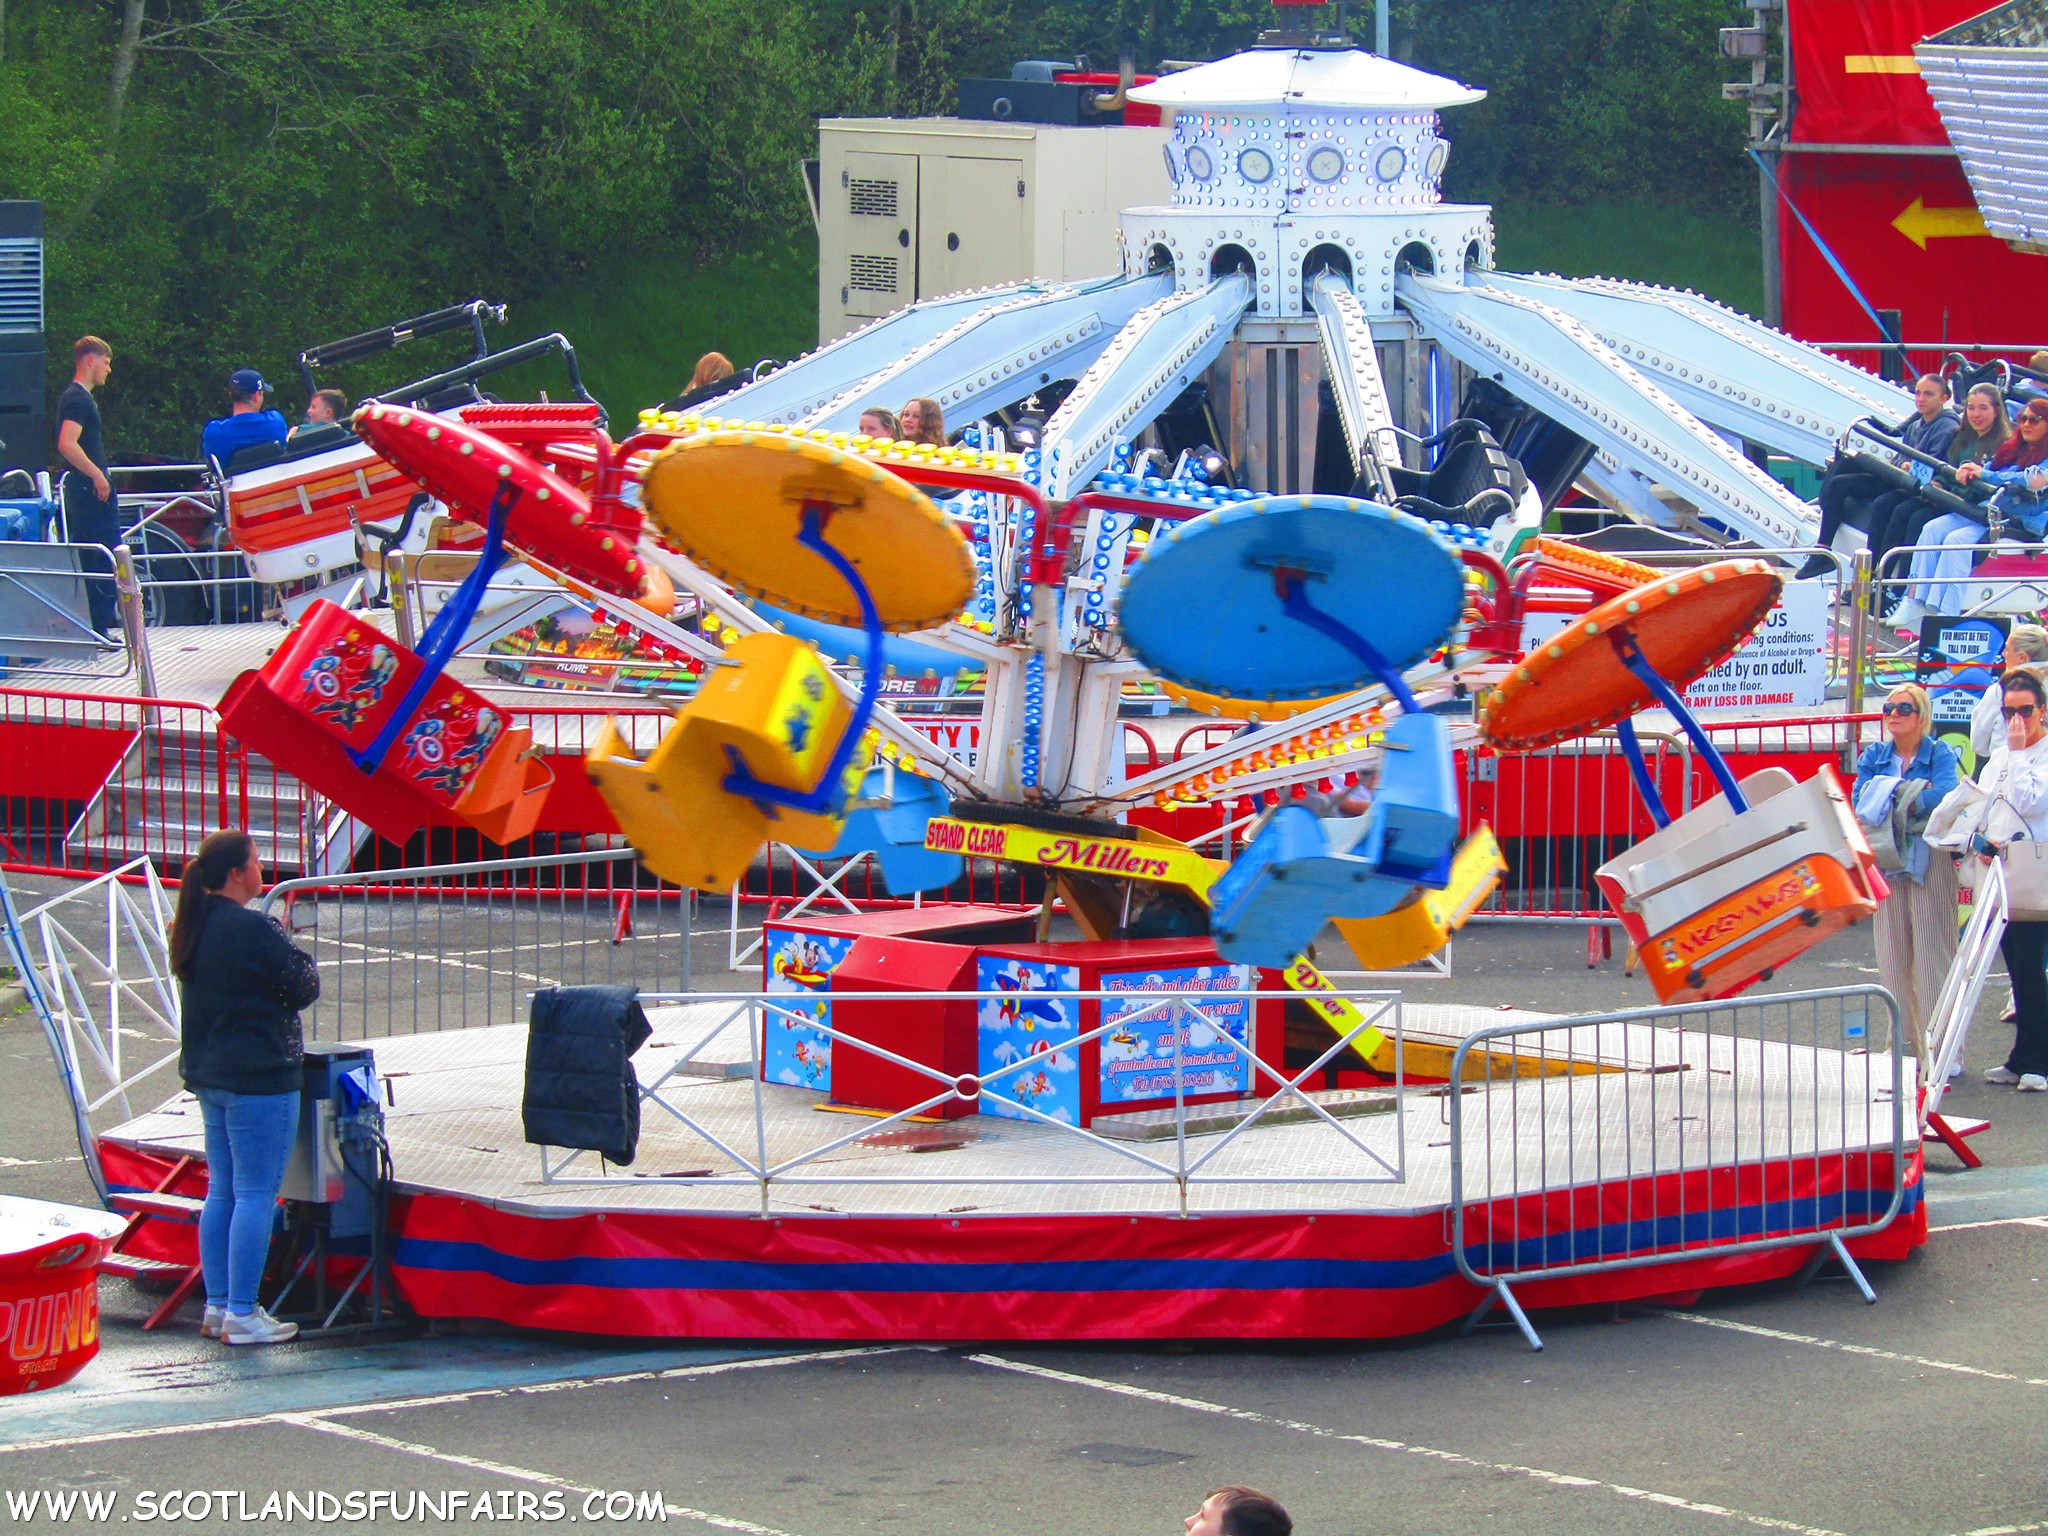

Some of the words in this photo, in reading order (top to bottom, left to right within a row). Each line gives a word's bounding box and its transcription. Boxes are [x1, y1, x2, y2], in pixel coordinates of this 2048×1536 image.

[1767, 631, 1814, 644] conditions:
[1942, 631, 1952, 641] YOU
[1953, 631, 1968, 641] MUST
[1969, 632, 1976, 641] BE
[1976, 632, 1989, 641] THIS
[1767, 648, 1789, 657] Alcohol
[1798, 647, 1816, 657] Drugs
[1948, 644, 1959, 653] TALL
[1960, 644, 1967, 654] TO
[1967, 645, 1980, 654] RIDE
[1735, 661, 1750, 680] by
[1753, 663, 1768, 676] an
[1771, 658, 1807, 675] adult.
[1689, 682, 1705, 693] left
[1708, 683, 1719, 692] on
[1722, 681, 1737, 692] the
[1740, 681, 1763, 691] floor.
[1694, 696, 1713, 708] ANY
[1715, 695, 1738, 707] LOSS
[1740, 694, 1752, 706] OR
[1755, 692, 1794, 705] DAMAGE
[927, 822, 965, 850] STAND
[967, 827, 1005, 855] CLEAR
[1037, 839, 1169, 877] Millers
[1109, 978, 1134, 991] This
[1160, 975, 1181, 991] and
[1182, 973, 1209, 991] other
[1212, 971, 1239, 990] rides
[1104, 1010, 1123, 1025] can
[1214, 999, 1244, 1016] event
[19, 1358, 58, 1375] START
